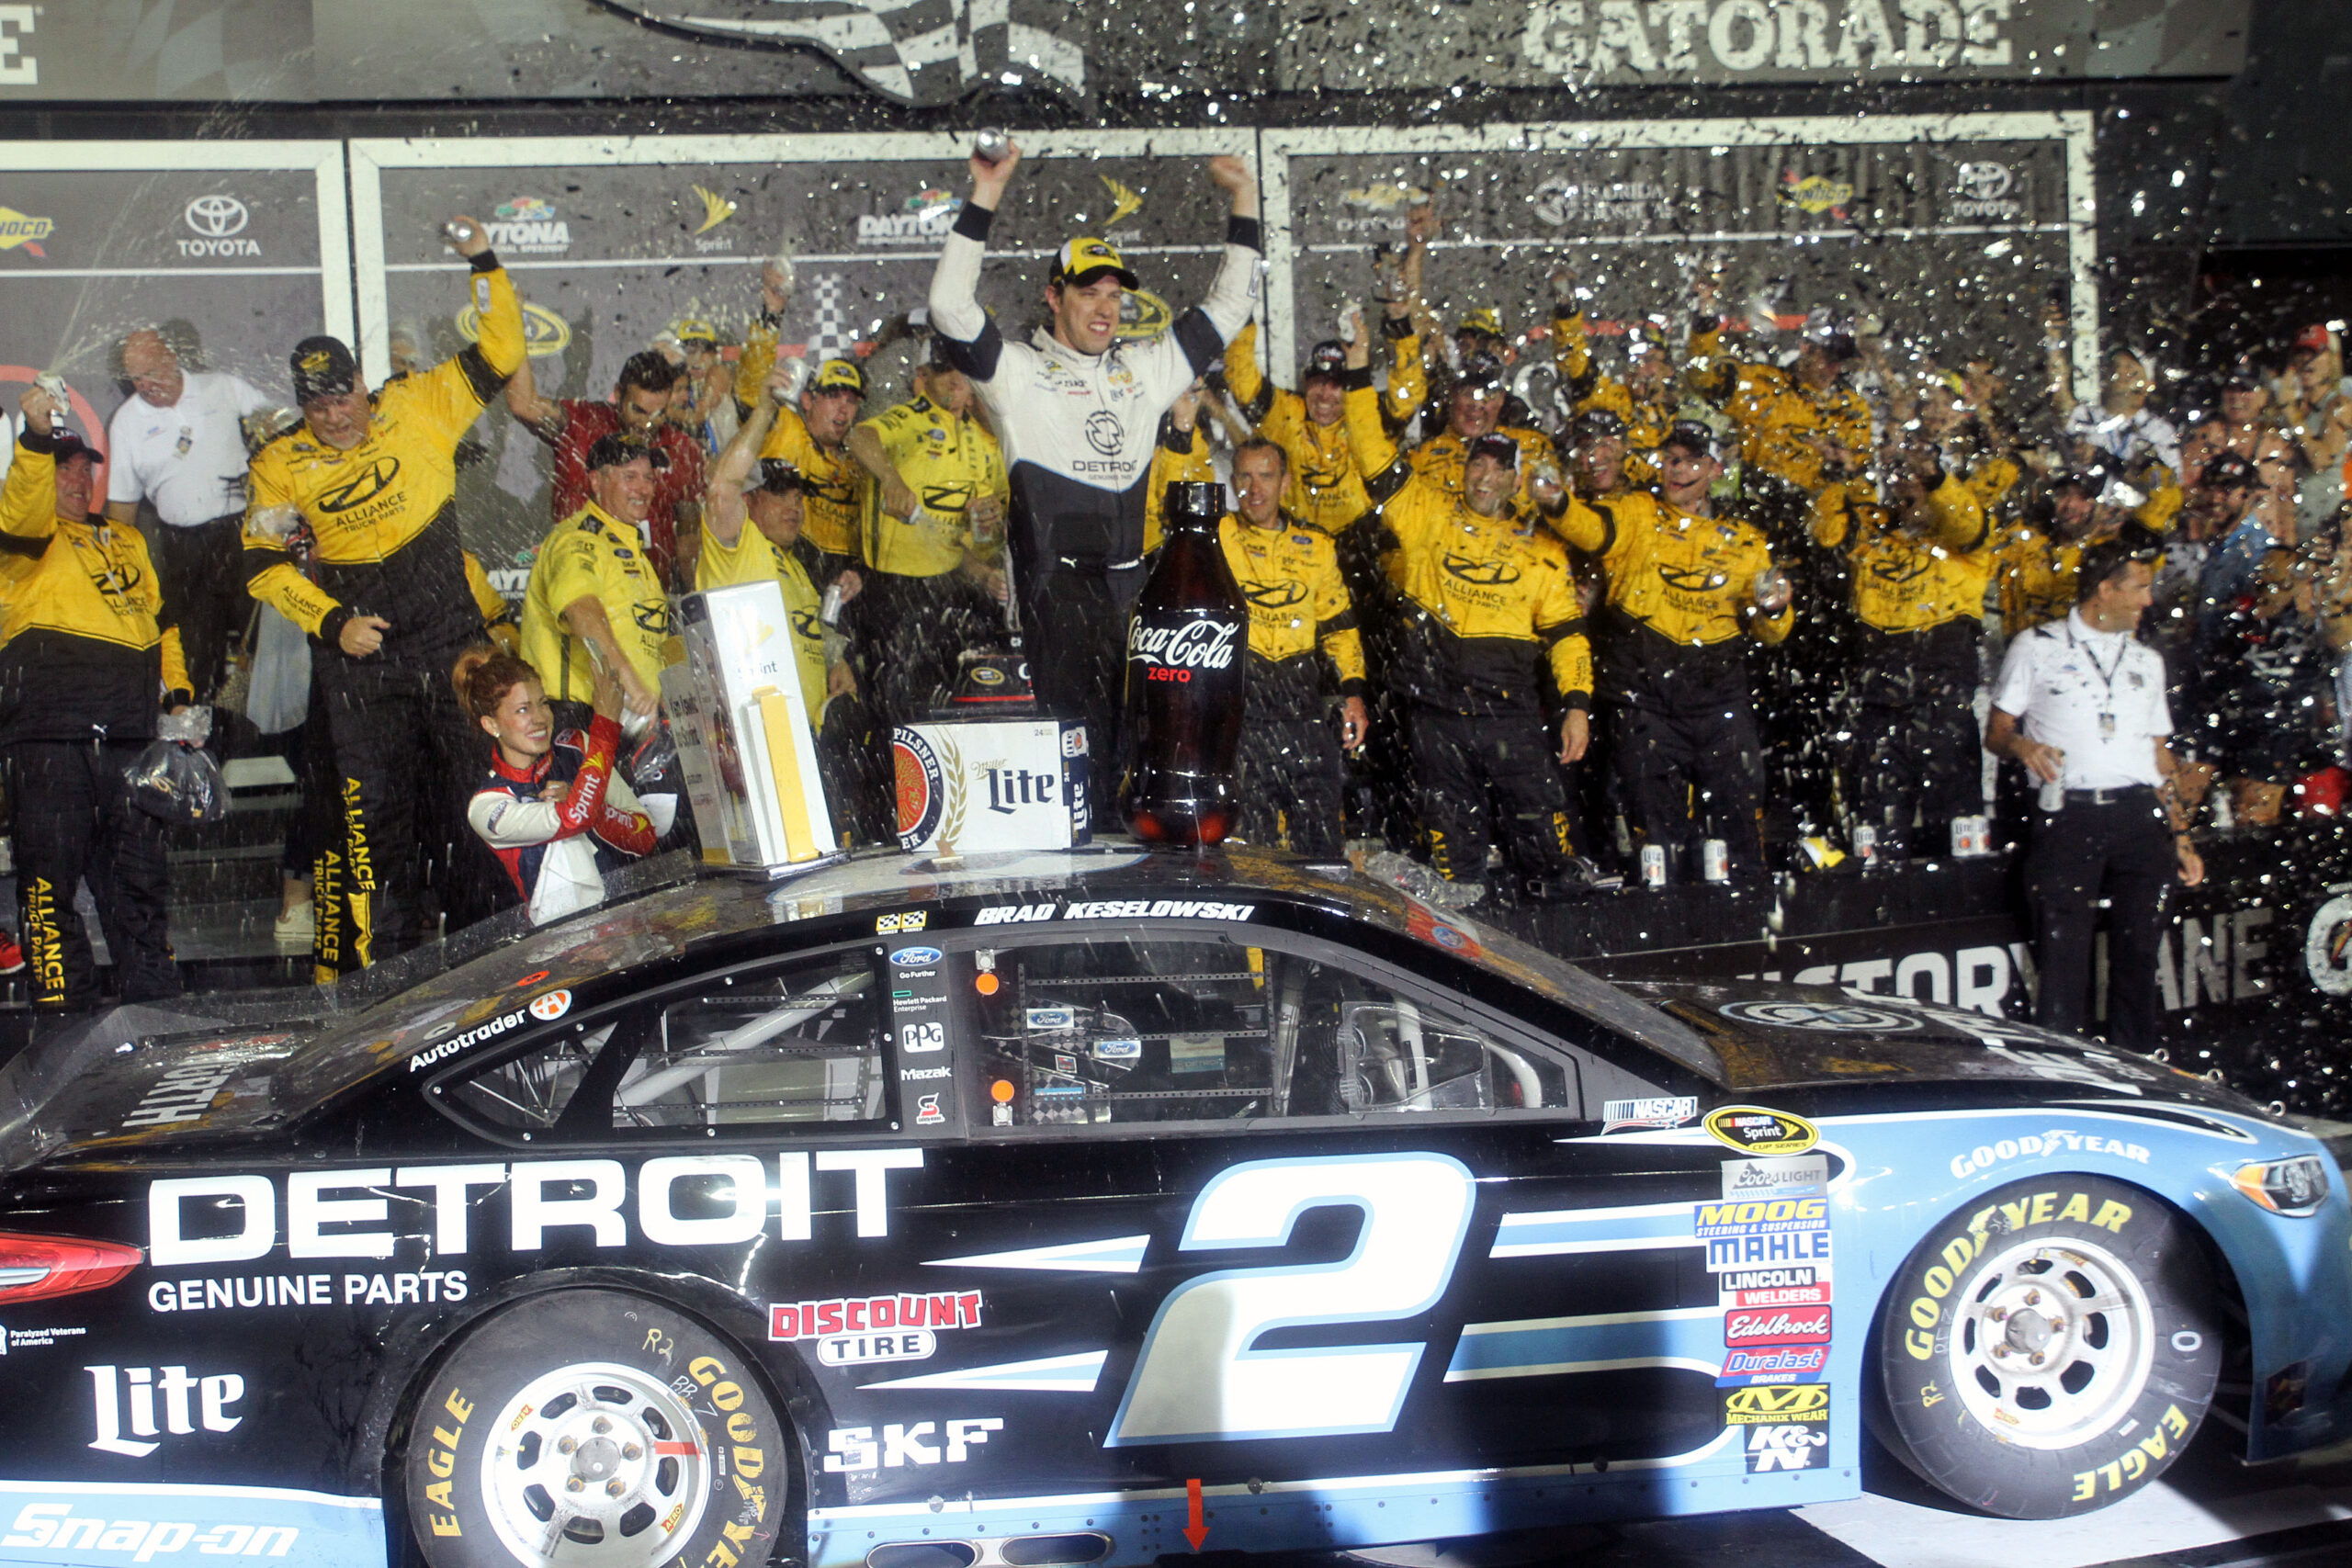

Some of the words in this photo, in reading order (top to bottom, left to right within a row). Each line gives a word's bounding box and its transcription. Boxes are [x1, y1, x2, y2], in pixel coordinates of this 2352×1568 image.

[1521, 0, 2012, 73] GATORADE
[480, 220, 572, 245] YTONA
[858, 213, 957, 237] DAYTON
[176, 239, 262, 257] TOYOTA
[336, 491, 408, 529] ALLIANCE
[1443, 578, 1507, 606] ALLIANCE
[1129, 615, 1239, 669] Coca-Cola
[1148, 667, 1193, 682] zero
[893, 727, 940, 781] PILSNER
[568, 773, 601, 824] Sprint
[987, 768, 1056, 815] Lite
[346, 776, 377, 892] ALLIANCE
[901, 832, 922, 850] ER
[323, 850, 343, 962] ALLIANCE
[974, 904, 1056, 925] BRAD
[1063, 900, 1255, 921] KESELOWSKI
[36, 876, 65, 990] ALLIANCE
[899, 950, 933, 964] Ford
[910, 970, 936, 978] Further
[893, 998, 919, 1007] Hewlett
[921, 996, 947, 1004] Packard
[894, 1003, 927, 1012] Enterprise
[1036, 1013, 1064, 1025] Ford
[410, 1009, 526, 1073] Autotrader
[1103, 1043, 1130, 1055] Ford
[900, 1066, 952, 1081] Mazak
[1633, 1098, 1695, 1119] NASCAR
[1735, 1116, 1770, 1127] NASCAR
[1743, 1126, 1781, 1140] Sprint
[1752, 1143, 1772, 1151] CUP
[1774, 1141, 1808, 1150] SERIES
[1737, 1168, 1781, 1187] Coors
[1782, 1169, 1822, 1183] LIGHT
[149, 1148, 924, 1266] DETROIT
[1696, 1199, 1828, 1227] MOOG
[1695, 1223, 1747, 1237] STEERING
[1748, 1223, 1758, 1234] &
[1760, 1220, 1827, 1234] SUSPENSION
[1710, 1232, 1829, 1265] MAHLE
[148, 1273, 333, 1313] GENUINE
[344, 1270, 469, 1306] PARTS
[1724, 1269, 1813, 1290] LINCOLN
[1105, 1152, 1477, 1448] 2
[1744, 1289, 1822, 1304] WELDERS
[770, 1292, 981, 1339] DISCOUNT
[1726, 1313, 1829, 1338] Edelbrock
[10, 1328, 50, 1338] Paralyzed
[51, 1327, 86, 1336] Veterans
[11, 1338, 19, 1347] of
[20, 1337, 53, 1347] America
[831, 1335, 921, 1359] TIRE
[1727, 1349, 1823, 1372] Duralast
[1750, 1373, 1797, 1384] BRAKES
[84, 1364, 245, 1458] Lite
[1726, 1412, 1790, 1425] MECHANIX
[1791, 1409, 1829, 1423] WEAR
[824, 1417, 1003, 1472] SKF
[2072, 1404, 2190, 1502] EAGLE
[426, 1388, 475, 1537] EAGLE
[663, 1506, 683, 1532] AERO
[0, 1503, 300, 1562] Snap-on
